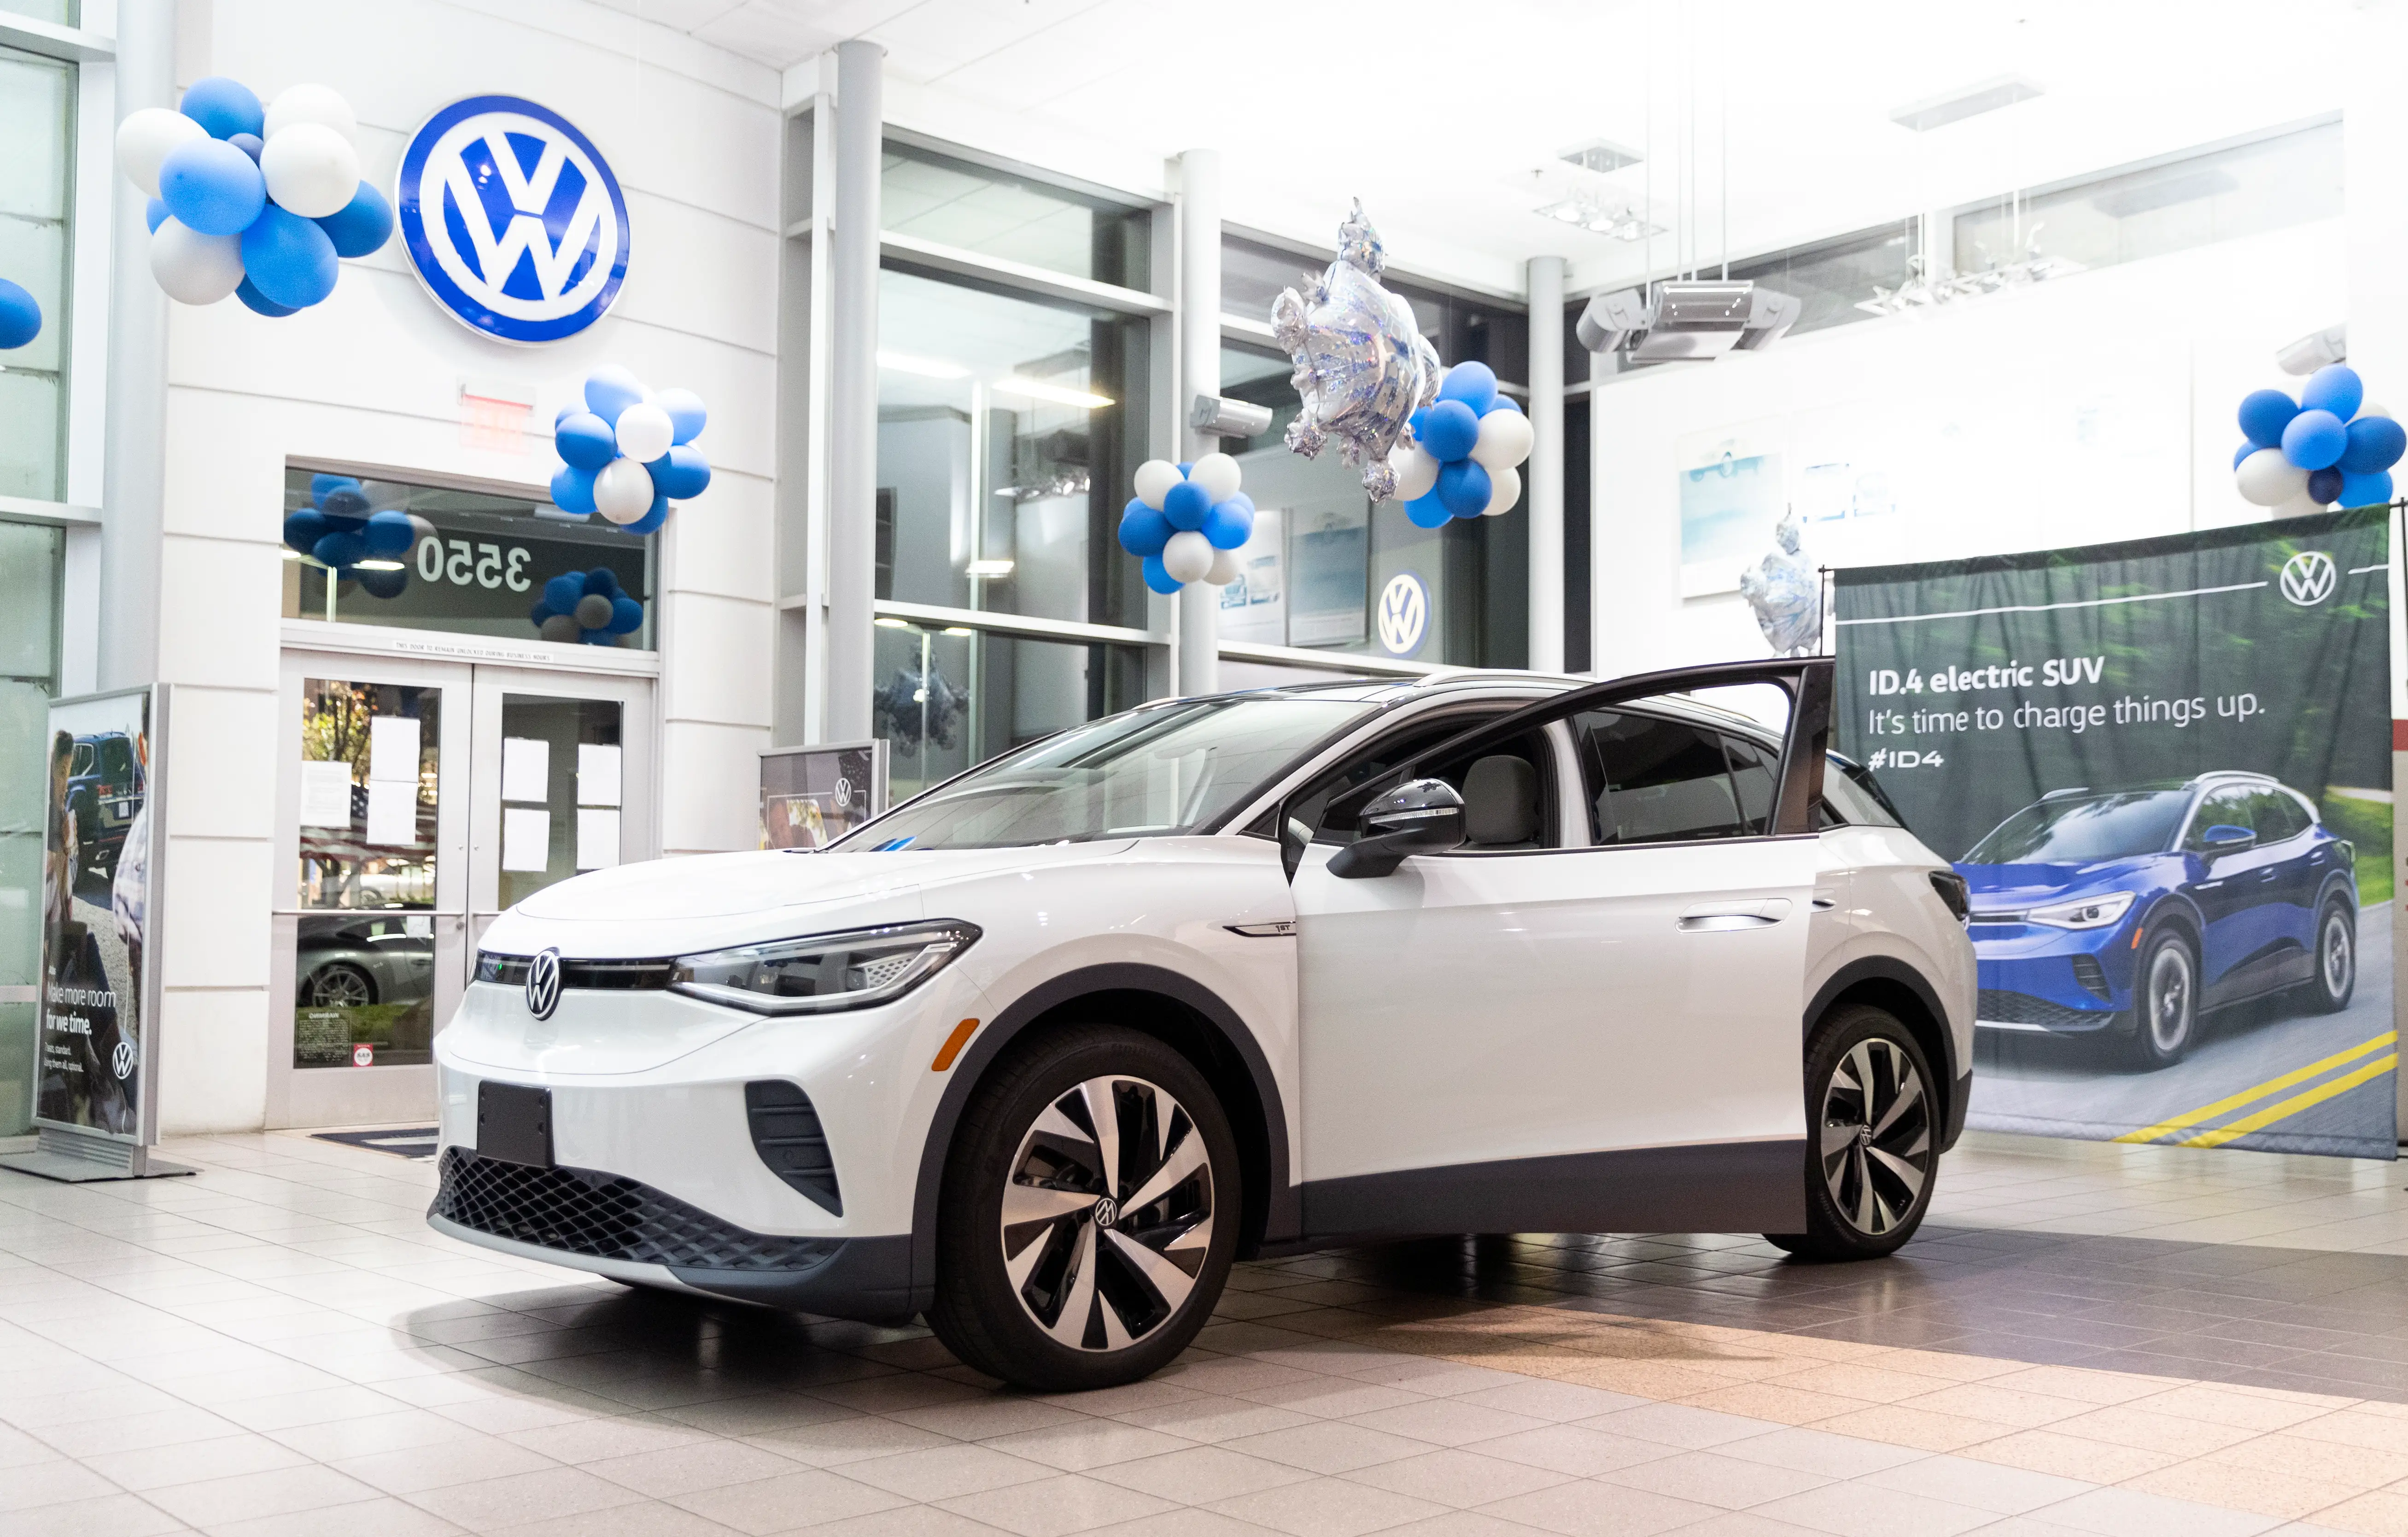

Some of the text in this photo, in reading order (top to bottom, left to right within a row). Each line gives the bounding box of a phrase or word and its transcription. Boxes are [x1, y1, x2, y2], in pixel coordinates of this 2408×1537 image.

[419, 112, 618, 322] VW
[2280, 551, 2337, 606] VW
[1378, 574, 1425, 653] VW
[1869, 656, 2105, 695] ID.4 electric SUV
[1869, 692, 2266, 735] It's time to charge things up.
[1868, 747, 1945, 772] #ID4
[835, 778, 851, 807] VW
[64, 988, 86, 1006] more
[88, 990, 116, 1008] room
[526, 950, 560, 1018] VW
[46, 1008, 92, 1035] for we time.
[112, 1041, 134, 1079] VW
